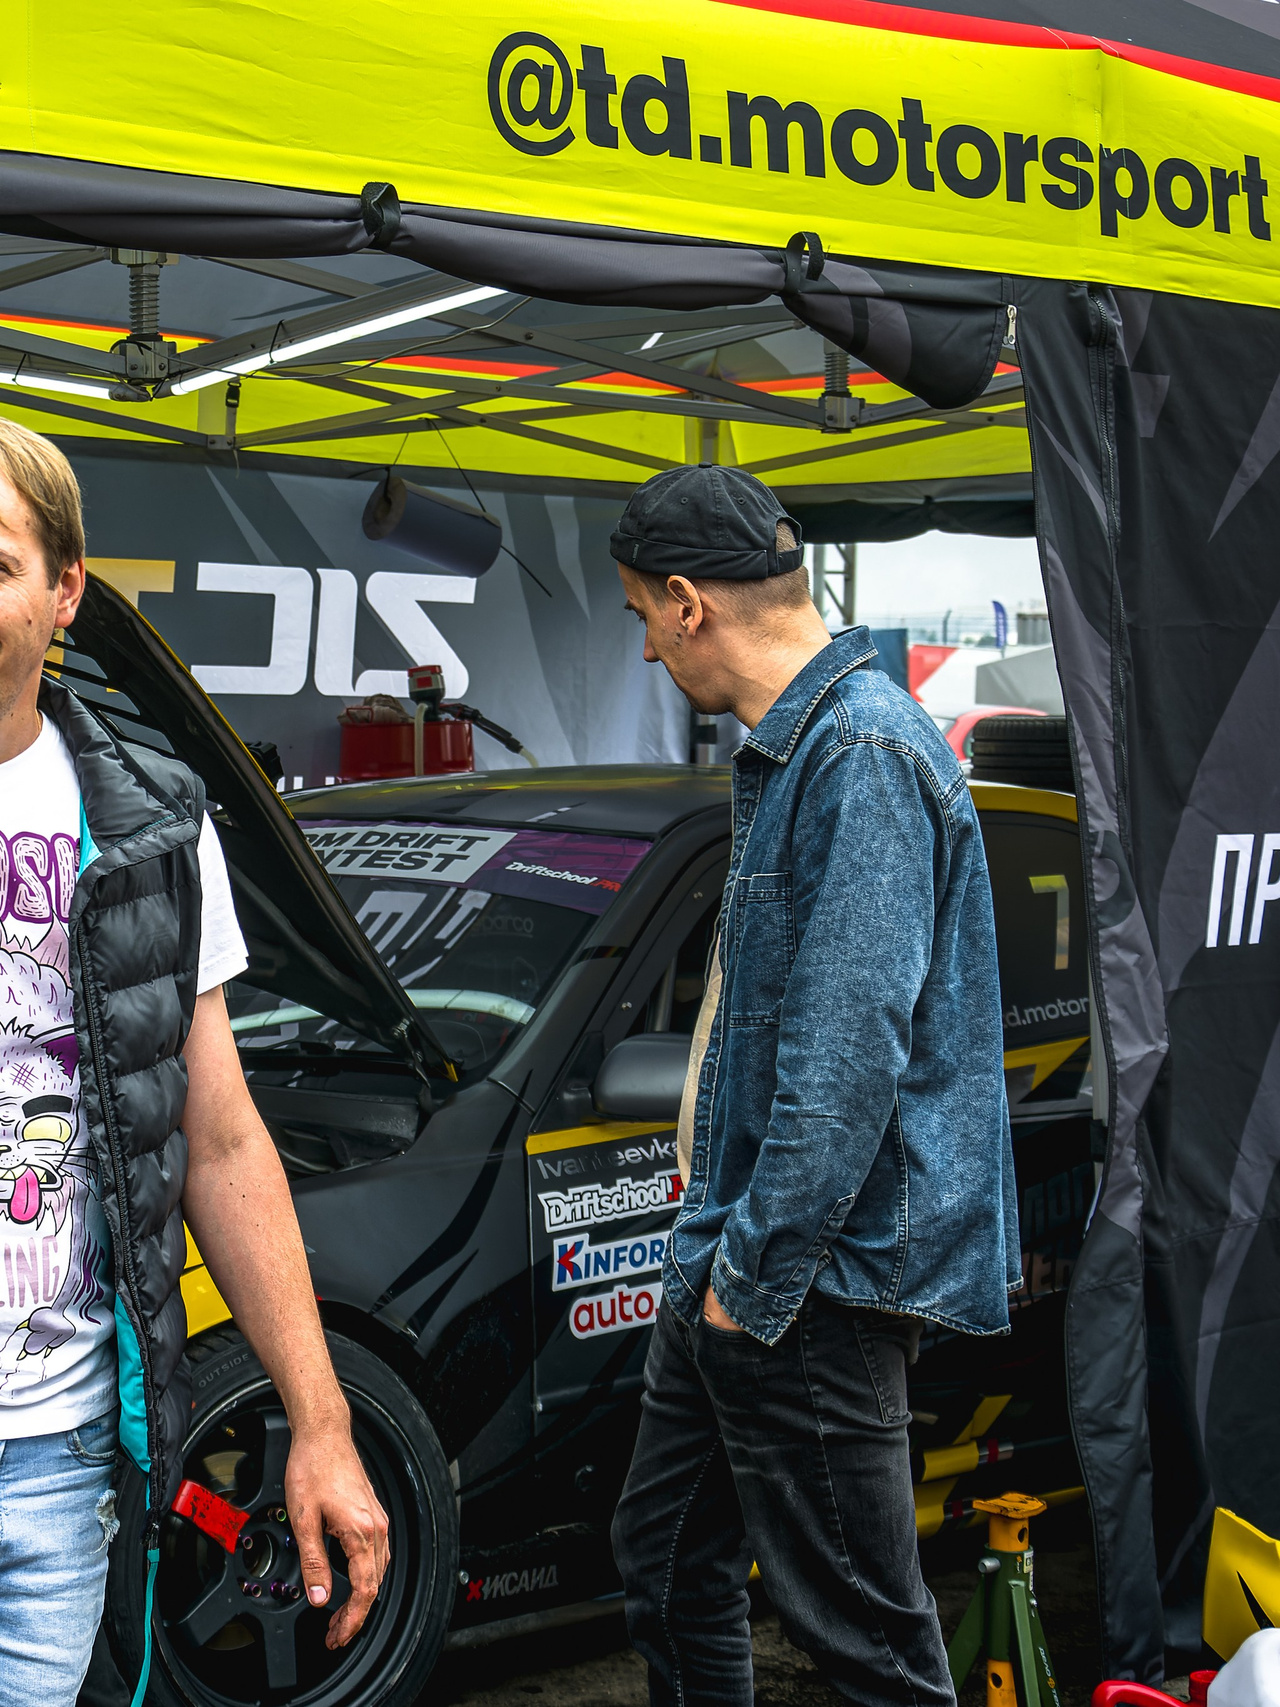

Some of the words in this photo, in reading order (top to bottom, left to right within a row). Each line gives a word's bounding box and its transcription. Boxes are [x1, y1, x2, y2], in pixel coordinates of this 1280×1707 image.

[486, 30, 1272, 241] @td.motorsport
[352, 830, 491, 852] DRIFT
[198, 1352, 251, 1390] OUTSIDE
